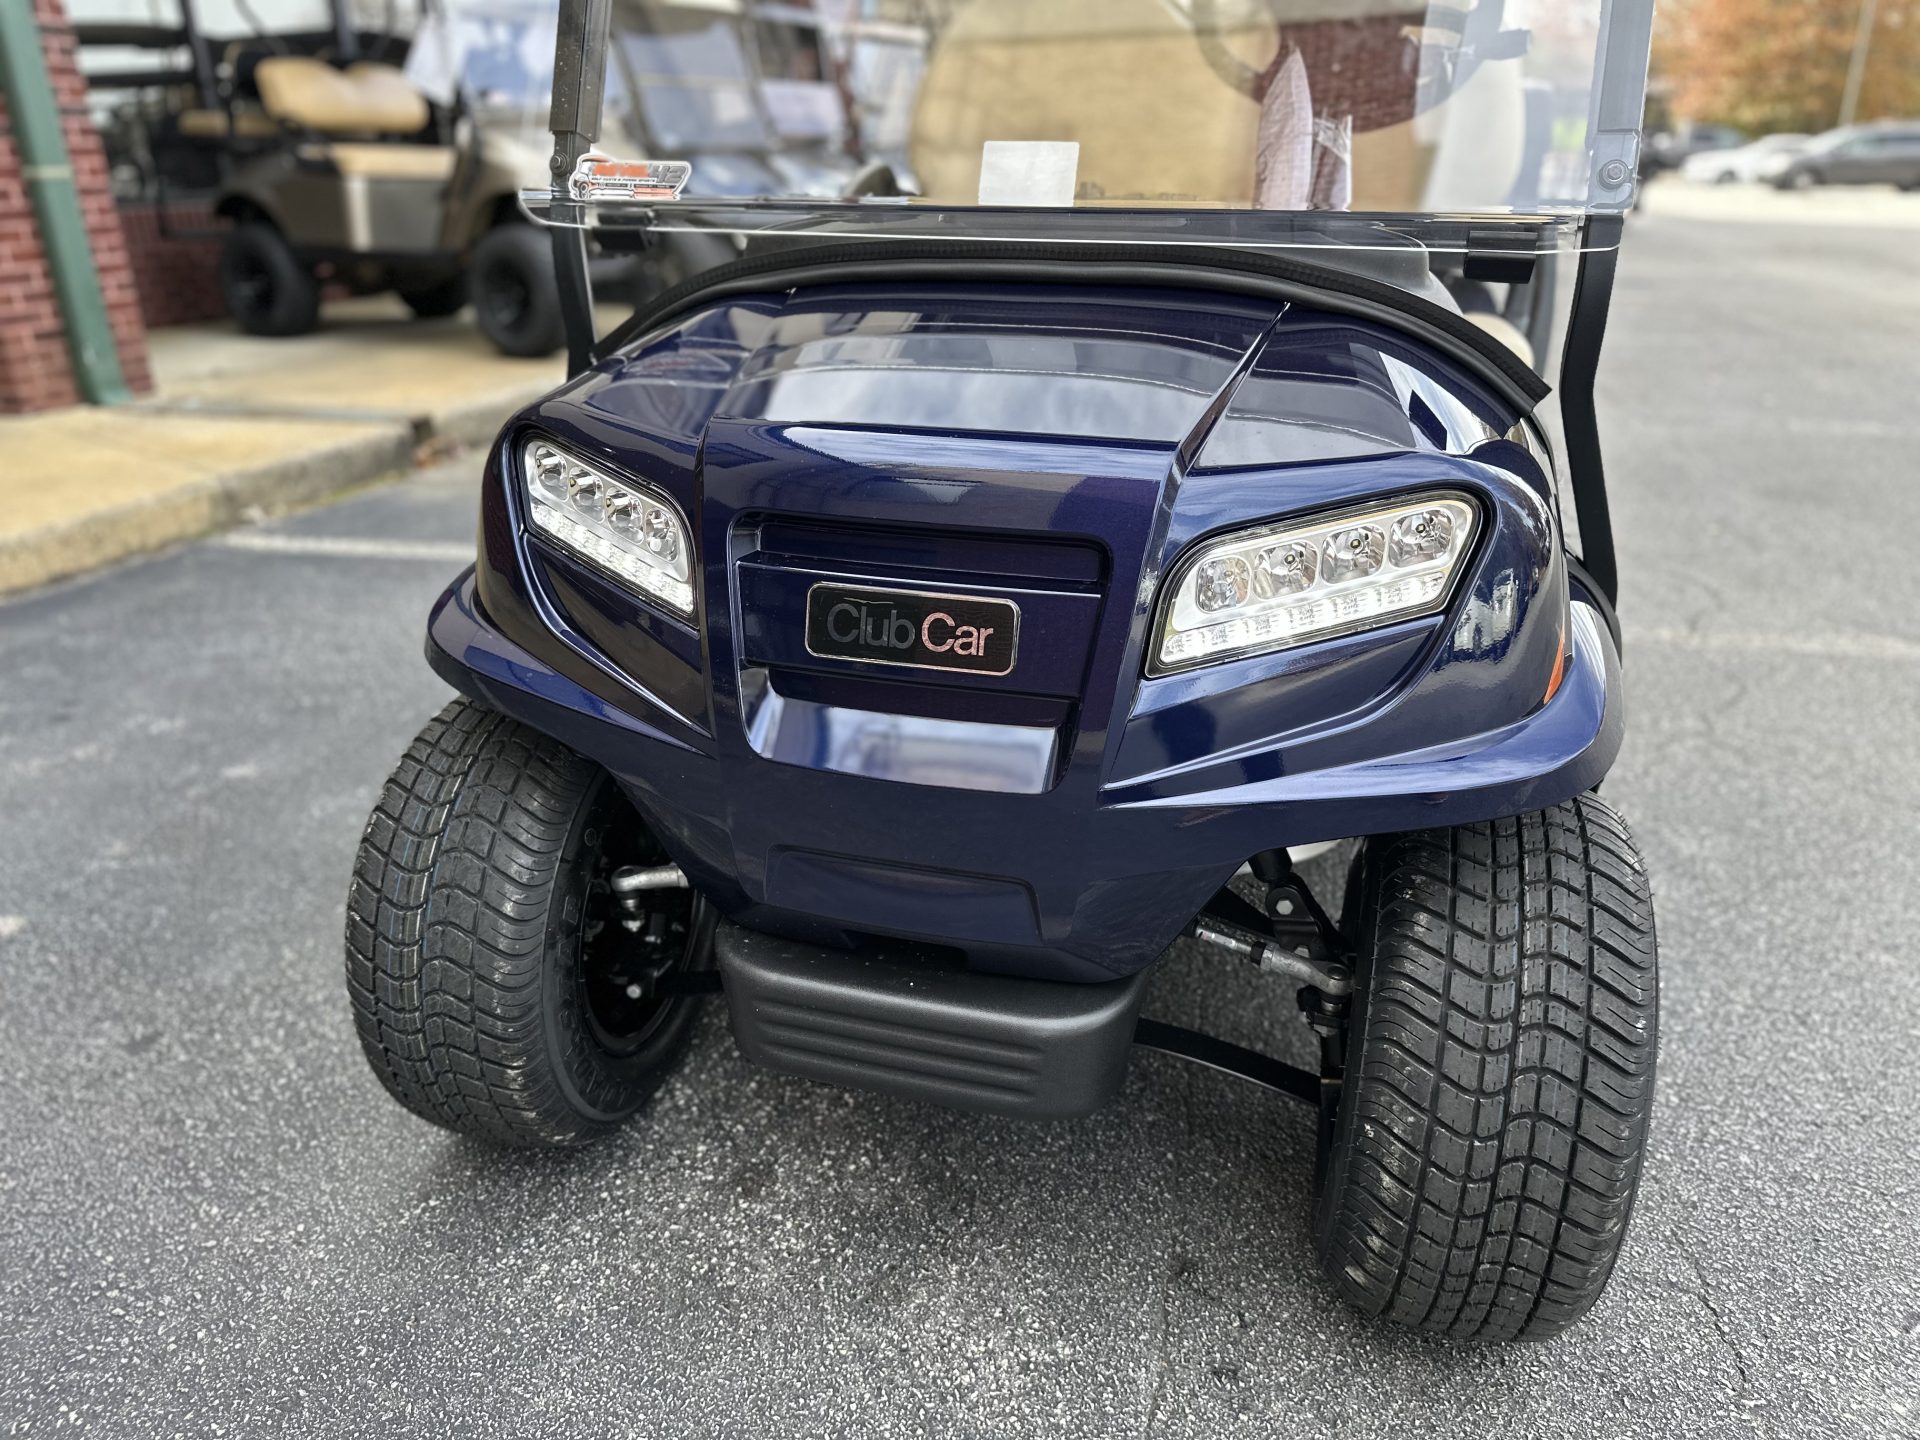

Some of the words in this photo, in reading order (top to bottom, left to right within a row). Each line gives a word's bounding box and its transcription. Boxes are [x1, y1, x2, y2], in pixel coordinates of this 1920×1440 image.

[650, 165, 687, 183] 42
[827, 603, 915, 649] Club
[921, 612, 994, 656] Car
